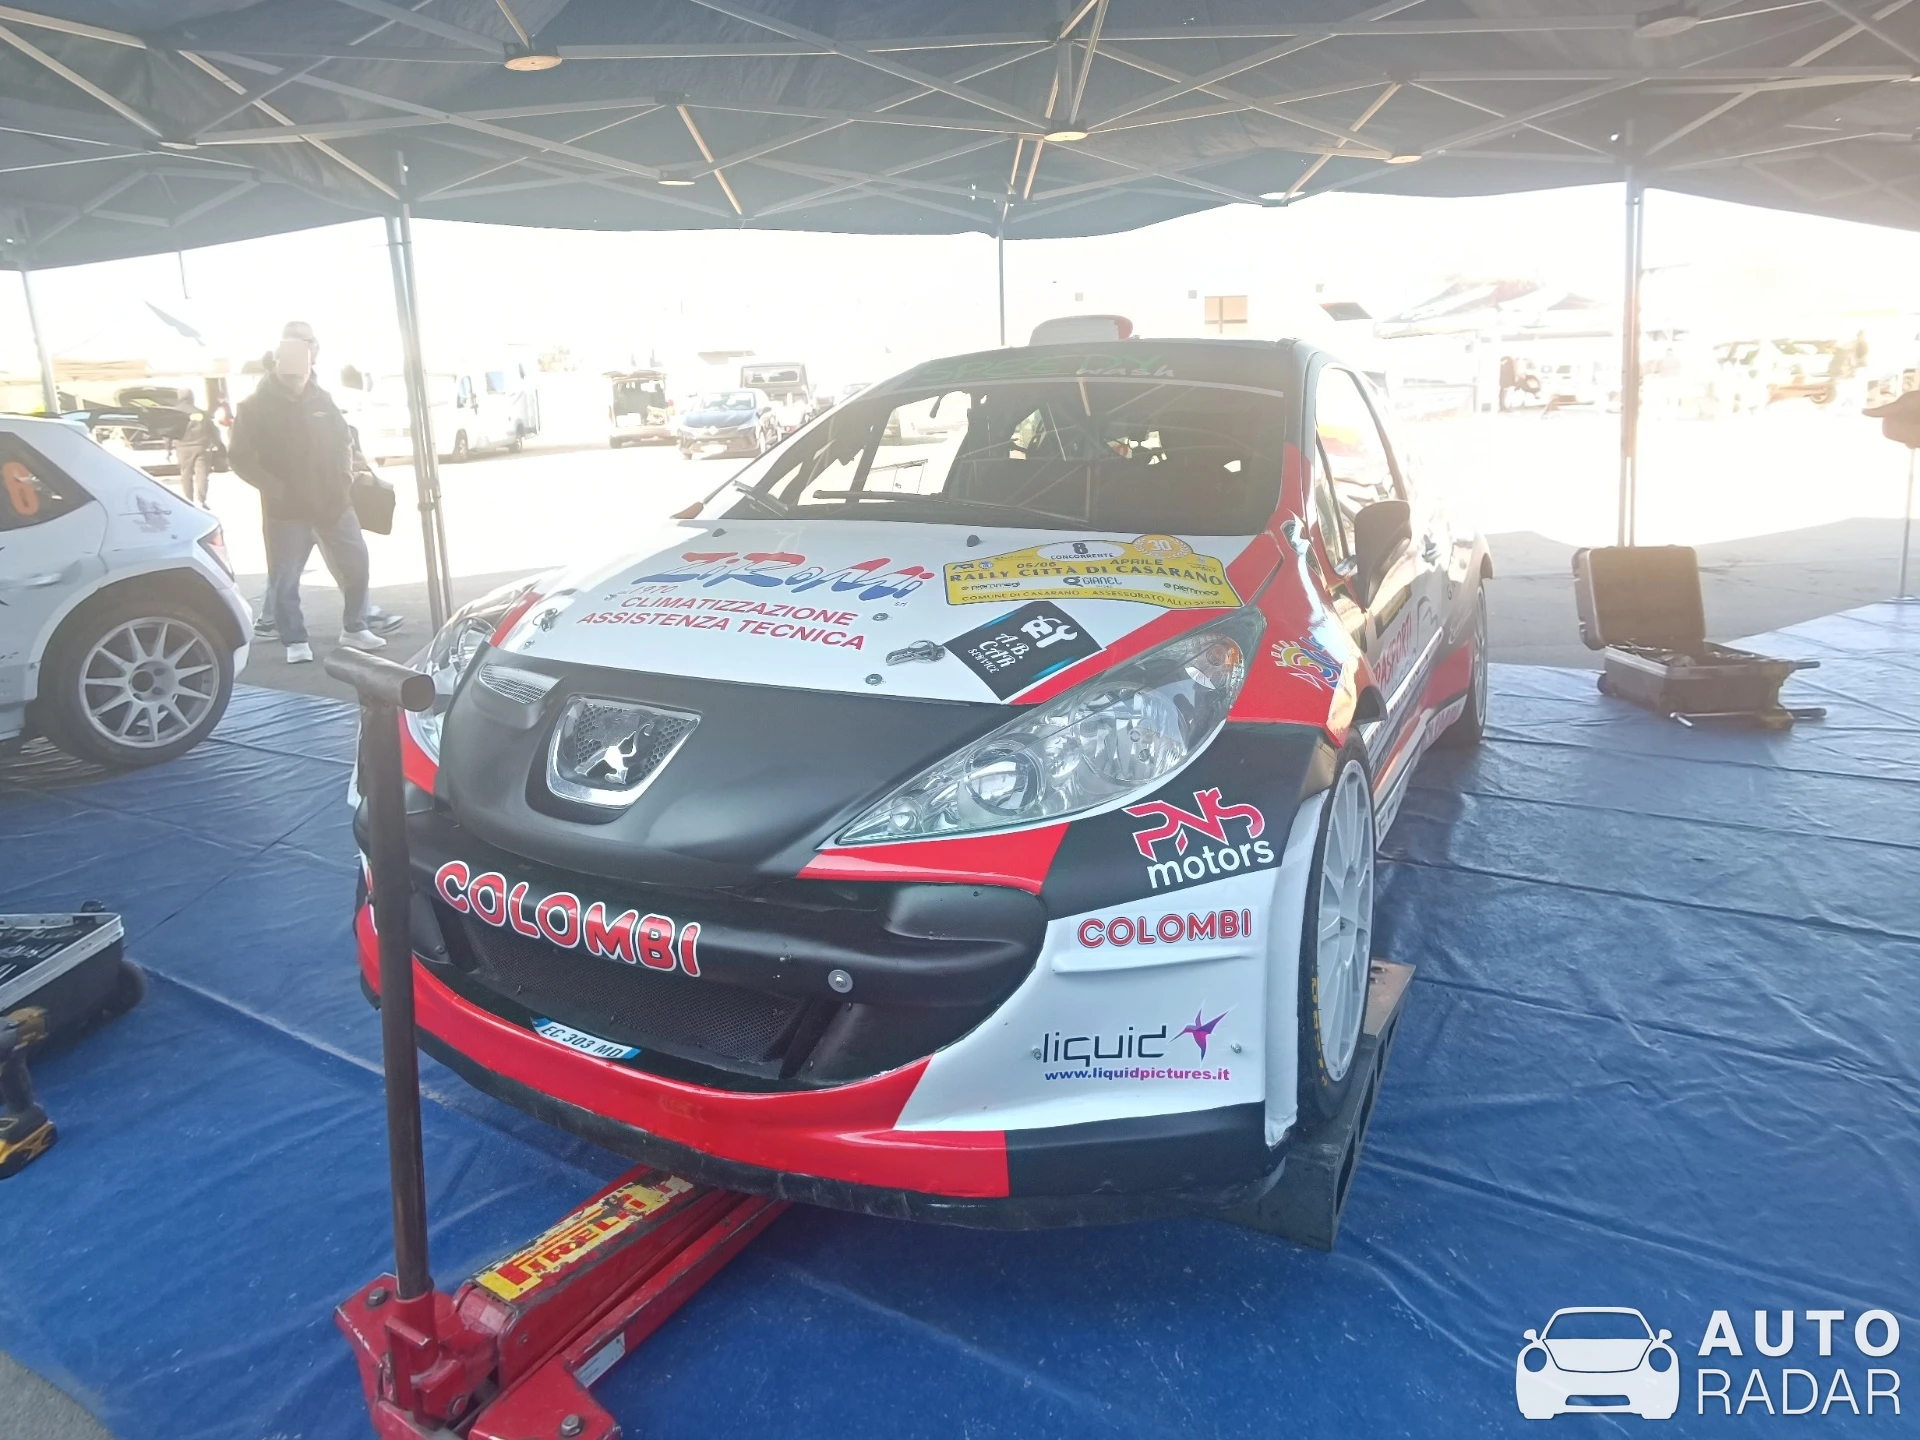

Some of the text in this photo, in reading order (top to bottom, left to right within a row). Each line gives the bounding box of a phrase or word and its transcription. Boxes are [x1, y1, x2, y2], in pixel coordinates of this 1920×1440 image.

[1076, 364, 1175, 378] wash
[1050, 552, 1114, 560] CONCORRENTE
[1072, 542, 1089, 555] 8
[1148, 539, 1173, 551] 30
[950, 570, 1010, 582] RALLY
[1018, 565, 1078, 577] CITTÀ
[1085, 566, 1108, 574] DI
[1116, 565, 1223, 585] CASARANO
[962, 592, 1007, 602] COMUNE
[1092, 590, 1165, 603] ASSESSORATO
[1167, 598, 1193, 606] ALLO
[621, 596, 860, 626] CLIMATIZZAZIONE
[576, 612, 865, 651] ASSISTENZA TECNICA
[967, 648, 1000, 674] SERVICE
[979, 640, 1016, 668] CAR
[1146, 839, 1274, 889] motors
[435, 860, 701, 977] COLOMBI
[1077, 908, 1252, 949] COLOMBI
[562, 1033, 596, 1050] 303
[1042, 1025, 1167, 1067] liquid
[1044, 1067, 1230, 1081] www.liquidpictures.it
